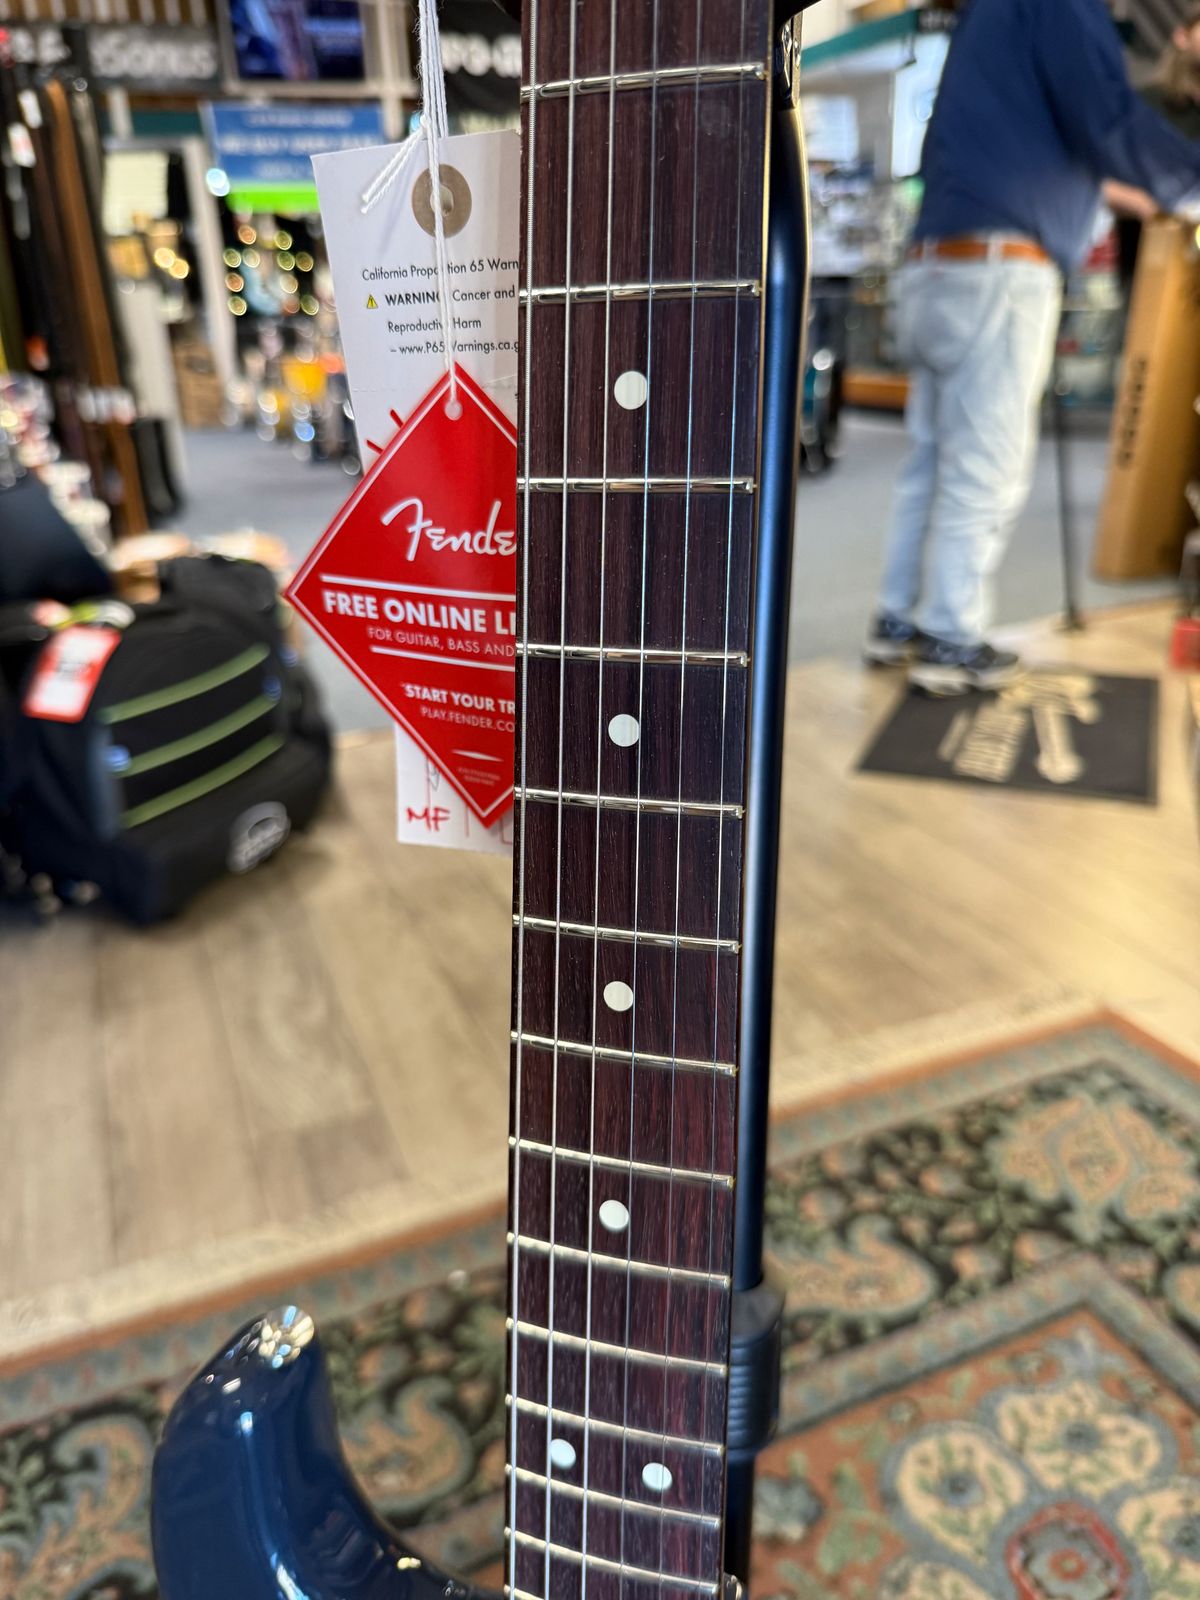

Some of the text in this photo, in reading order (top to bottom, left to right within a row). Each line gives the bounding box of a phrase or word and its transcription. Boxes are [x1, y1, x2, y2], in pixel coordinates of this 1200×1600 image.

[362, 258, 519, 281] California Propotion 65 Warn
[452, 289, 491, 302] Cancer
[494, 284, 516, 299] and
[453, 317, 482, 330] Harm
[381, 498, 517, 562] Fende
[323, 591, 379, 620] FREE
[384, 599, 488, 634] ONLINE
[367, 627, 515, 657] FOR GUITAR, BASS AND
[404, 684, 515, 715] START YOUR TR
[421, 707, 515, 732] PLAY.FENDER.CO
[406, 807, 450, 832] MF
